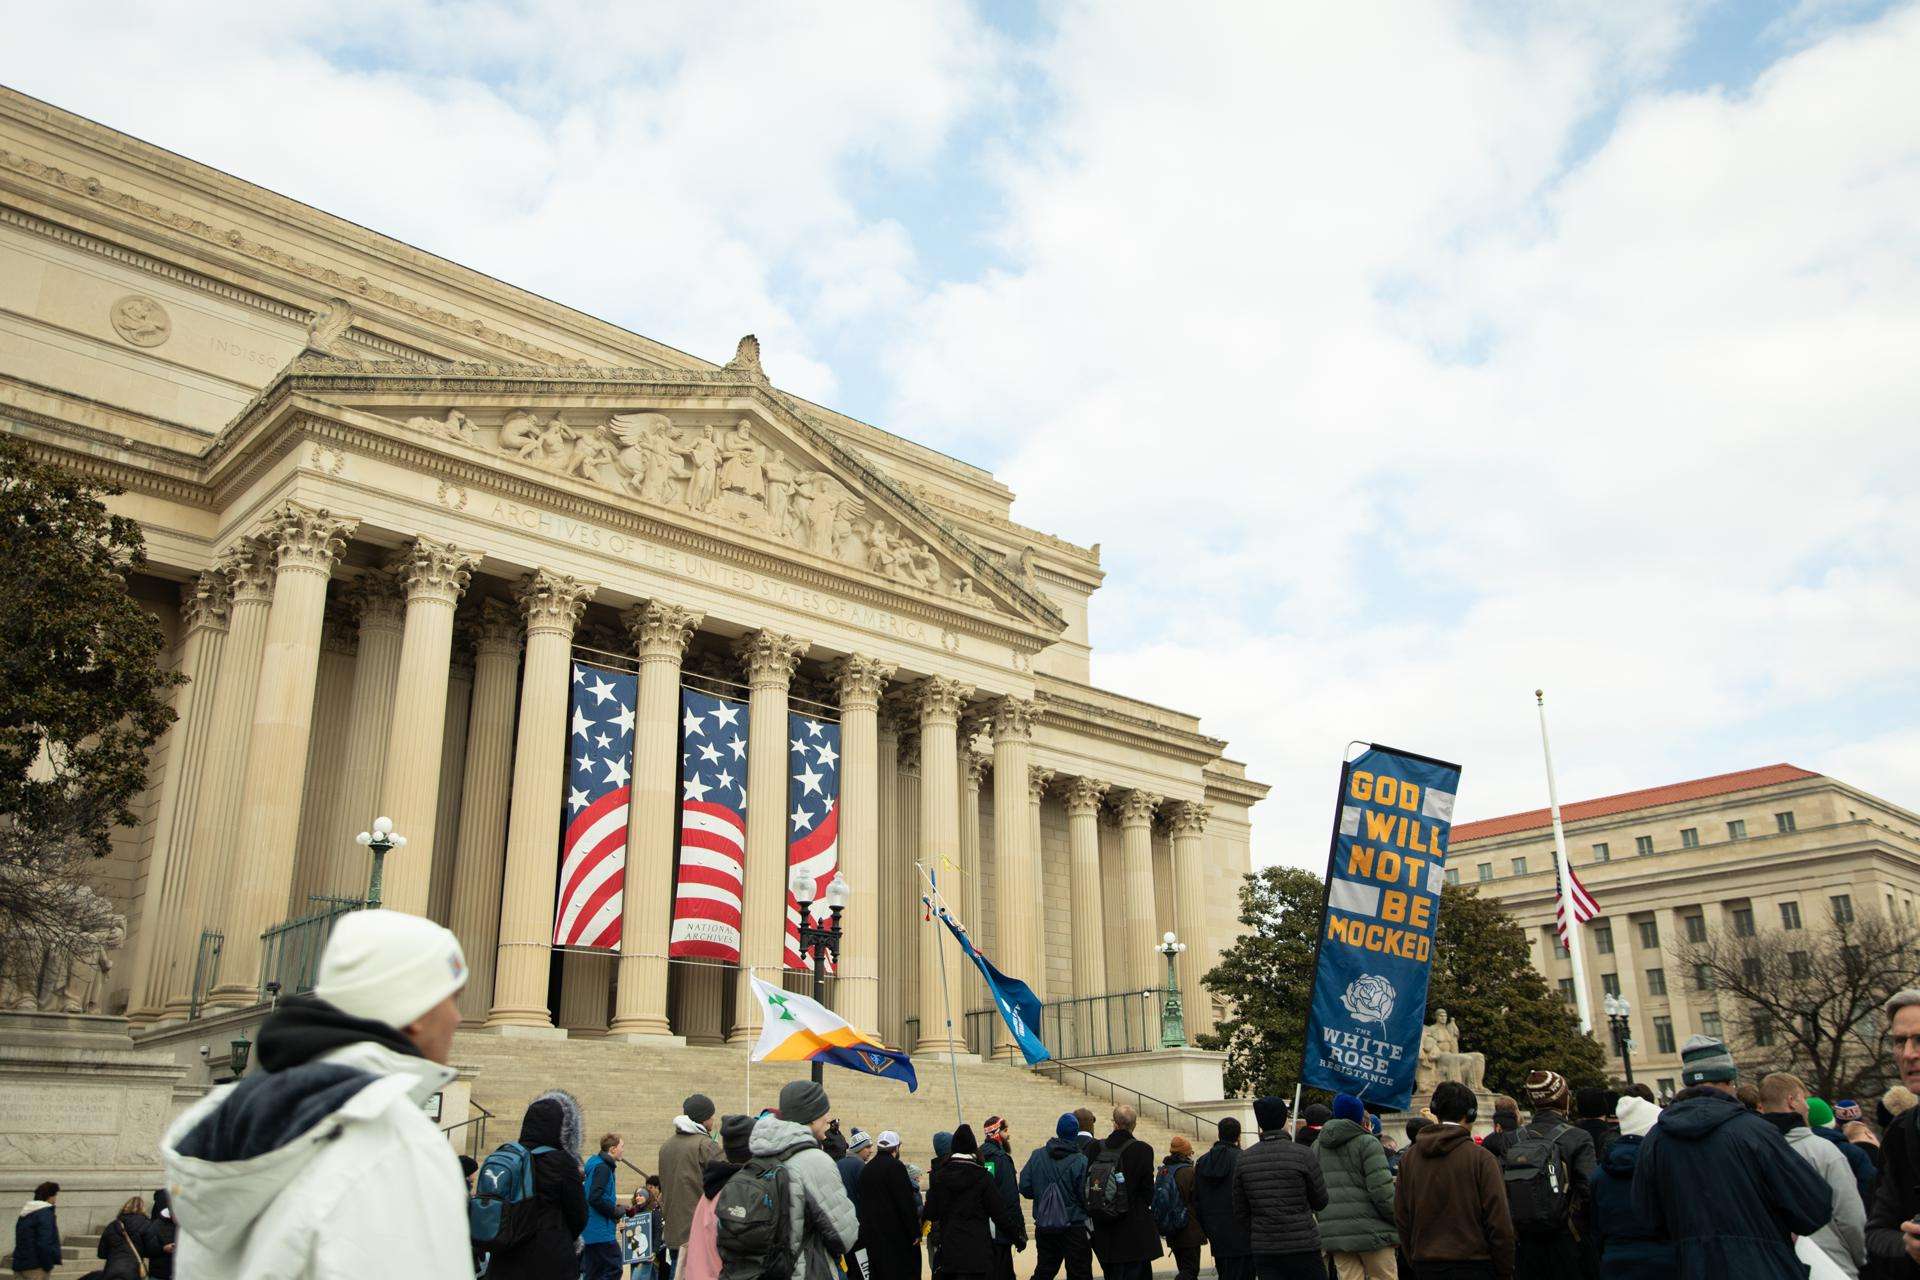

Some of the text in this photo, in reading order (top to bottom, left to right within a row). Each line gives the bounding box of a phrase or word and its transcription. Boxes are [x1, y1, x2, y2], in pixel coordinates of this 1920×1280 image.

[210, 336, 280, 368] INDISSO
[491, 502, 927, 640] ARCHIVES OF THE UNITED STATES OF AMERICA
[1351, 771, 1420, 811] GOD
[1365, 809, 1443, 857] WILL
[1348, 844, 1425, 887] NOT
[1382, 889, 1431, 929] BE
[685, 933, 733, 943] ARCHIVES
[687, 923, 734, 934] NATIONAL
[1328, 914, 1430, 962] MOCKED
[1323, 1026, 1403, 1060] WHITE
[1355, 1027, 1371, 1036] THE
[1319, 1058, 1394, 1087] RESISTANCE
[1330, 1046, 1390, 1074] ROSE
